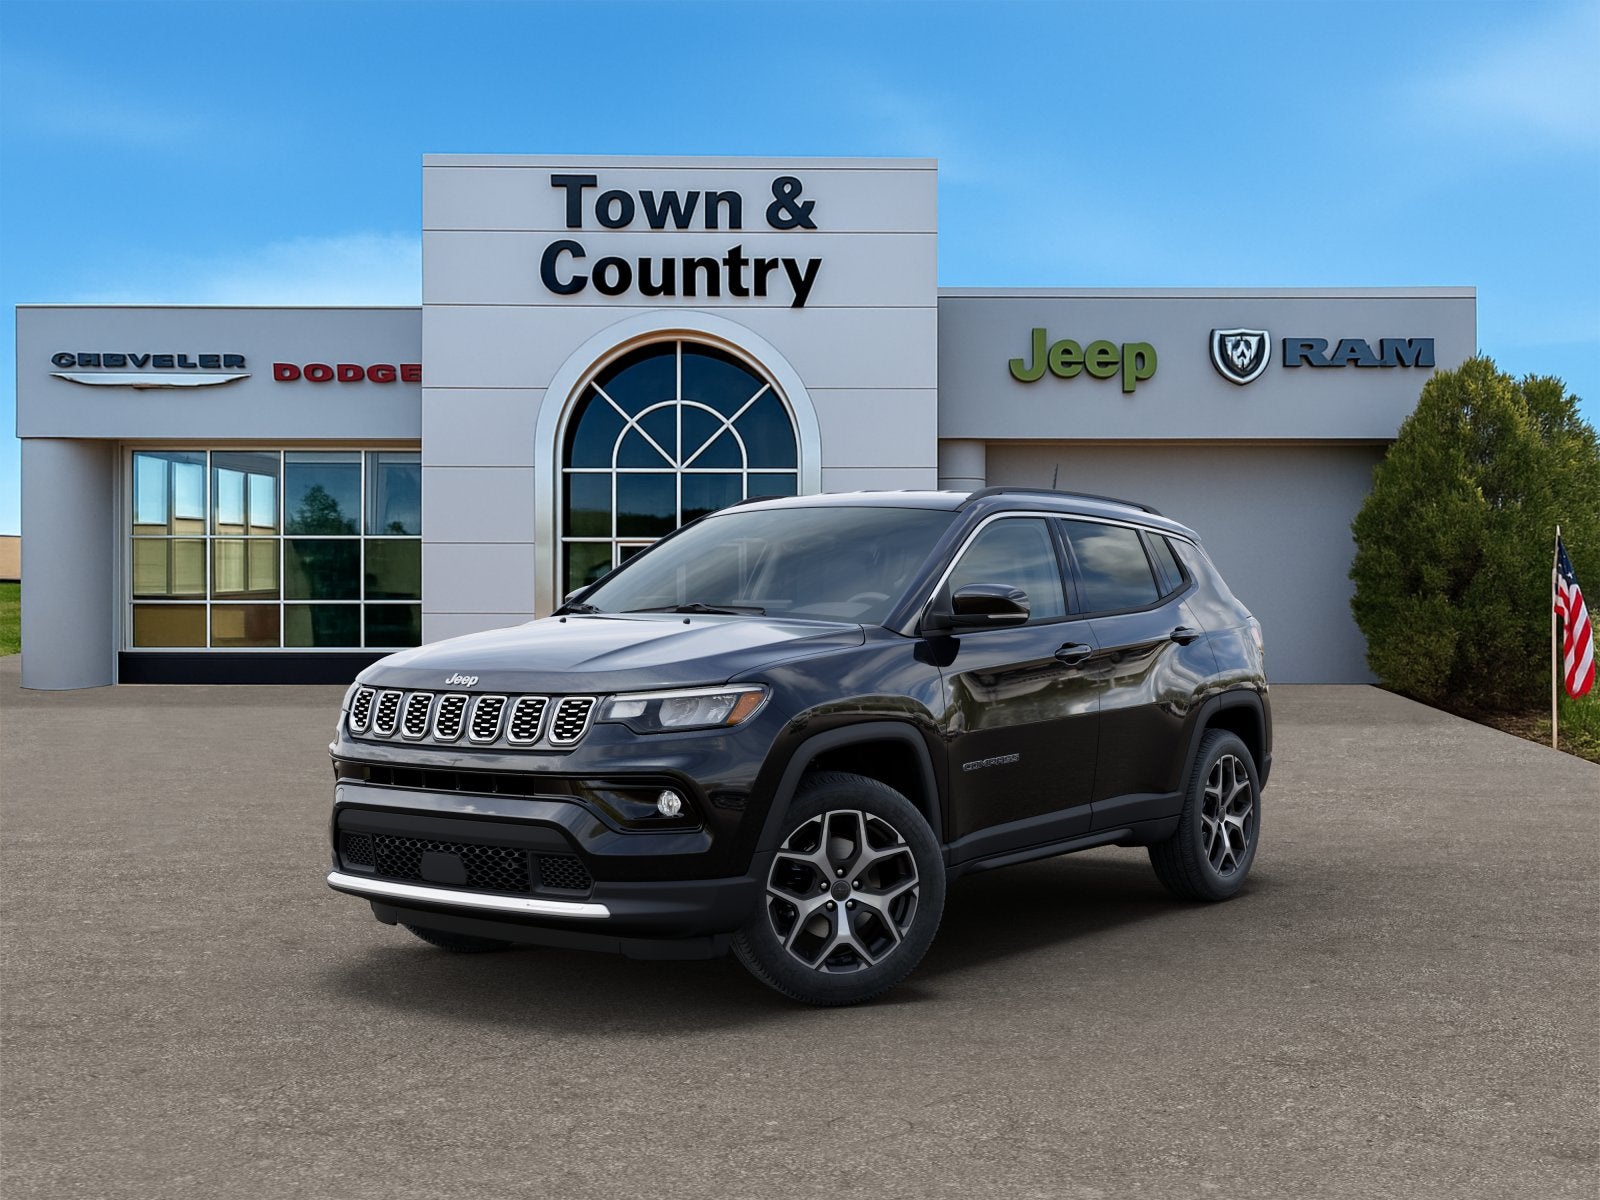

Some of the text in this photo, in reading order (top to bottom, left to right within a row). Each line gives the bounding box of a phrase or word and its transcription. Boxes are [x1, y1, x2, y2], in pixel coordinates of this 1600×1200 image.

[550, 173, 818, 230] Town &
[540, 238, 822, 308] Country
[273, 362, 422, 382] DODGE
[1009, 327, 1157, 393] Jeep
[1282, 337, 1436, 368] RAM
[445, 672, 479, 688] Jeep
